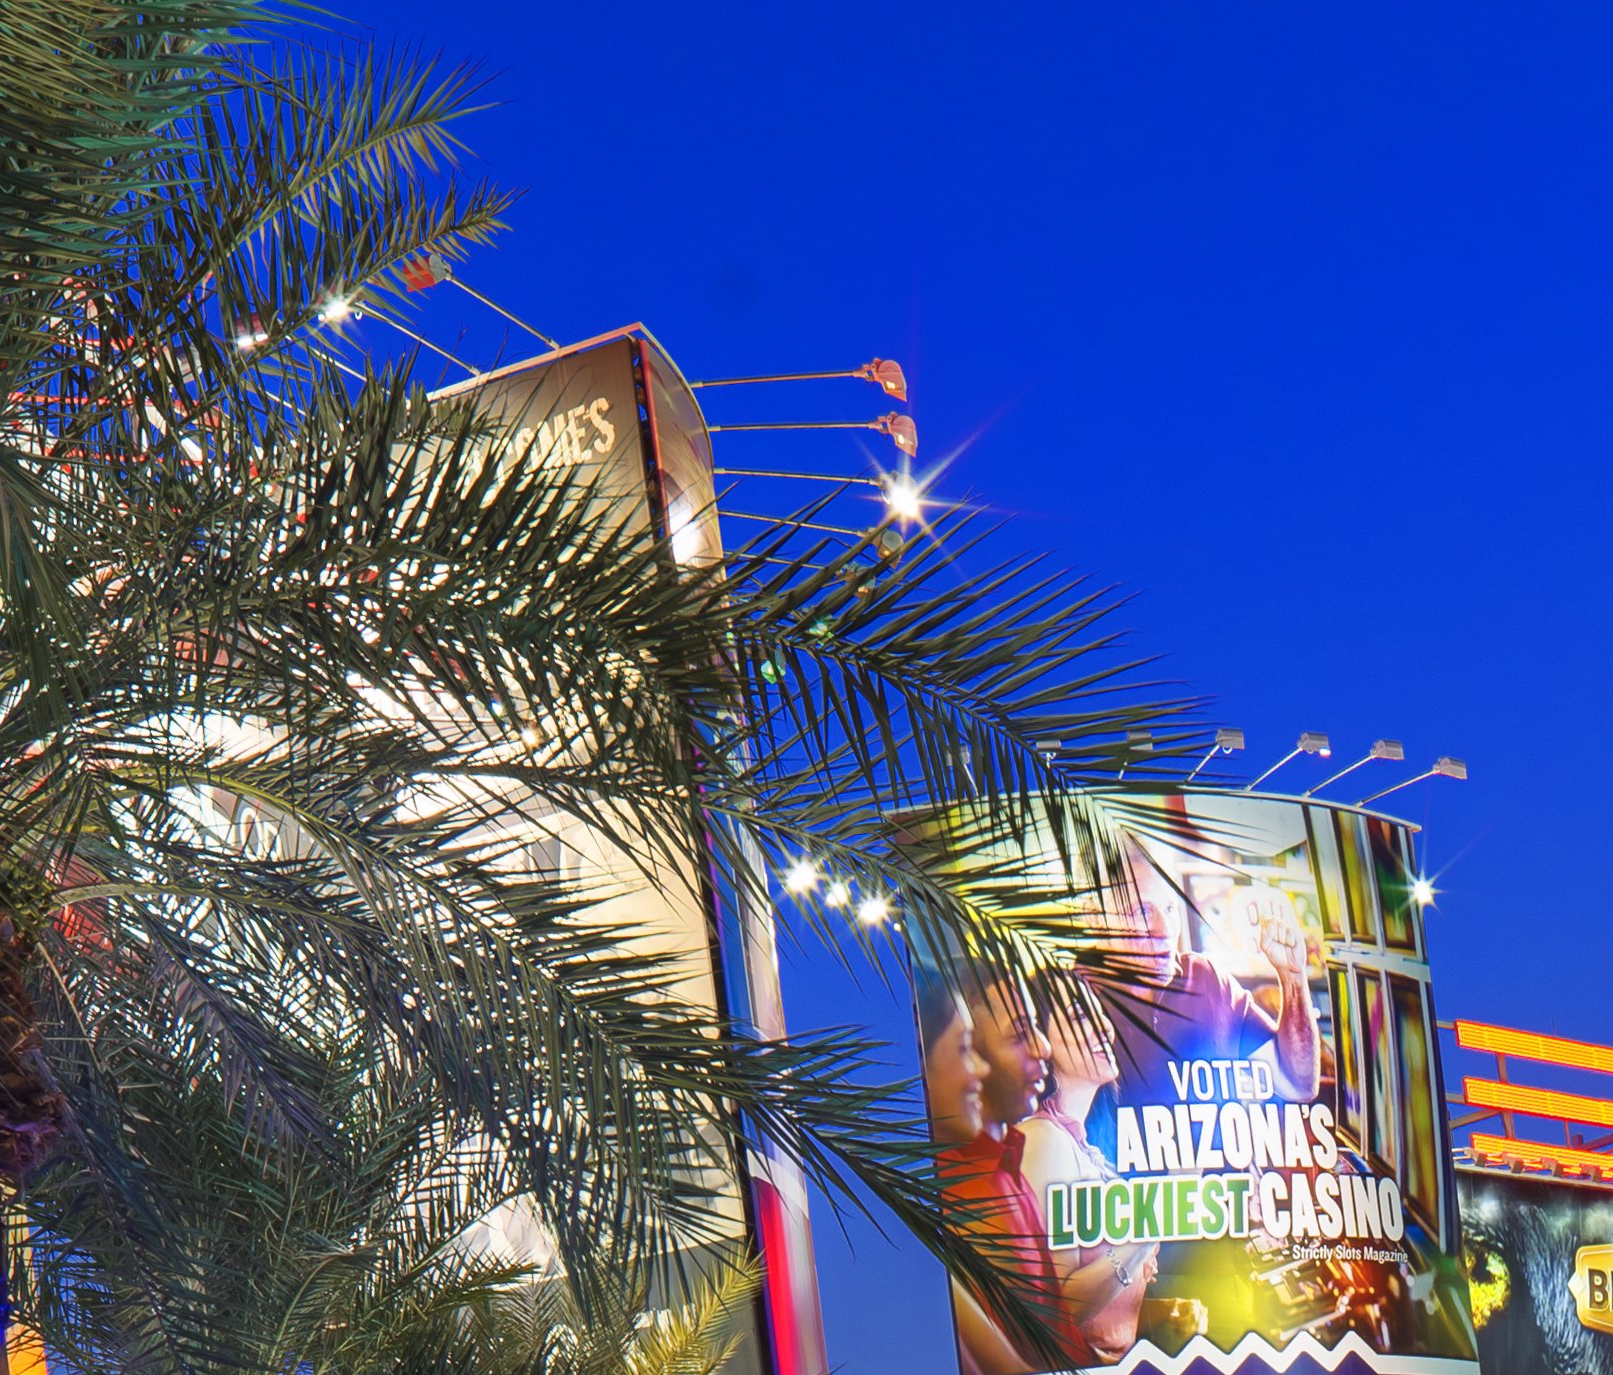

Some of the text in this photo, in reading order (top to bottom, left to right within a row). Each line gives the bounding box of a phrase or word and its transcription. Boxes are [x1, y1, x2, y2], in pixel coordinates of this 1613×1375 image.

[1168, 1060, 1274, 1102] VOTED
[1115, 1101, 1341, 1173] ARIZONA'S
[1045, 1175, 1405, 1251] LUCKIEST CASINO
[1292, 1244, 1408, 1264] Strictly Slots Magazine
